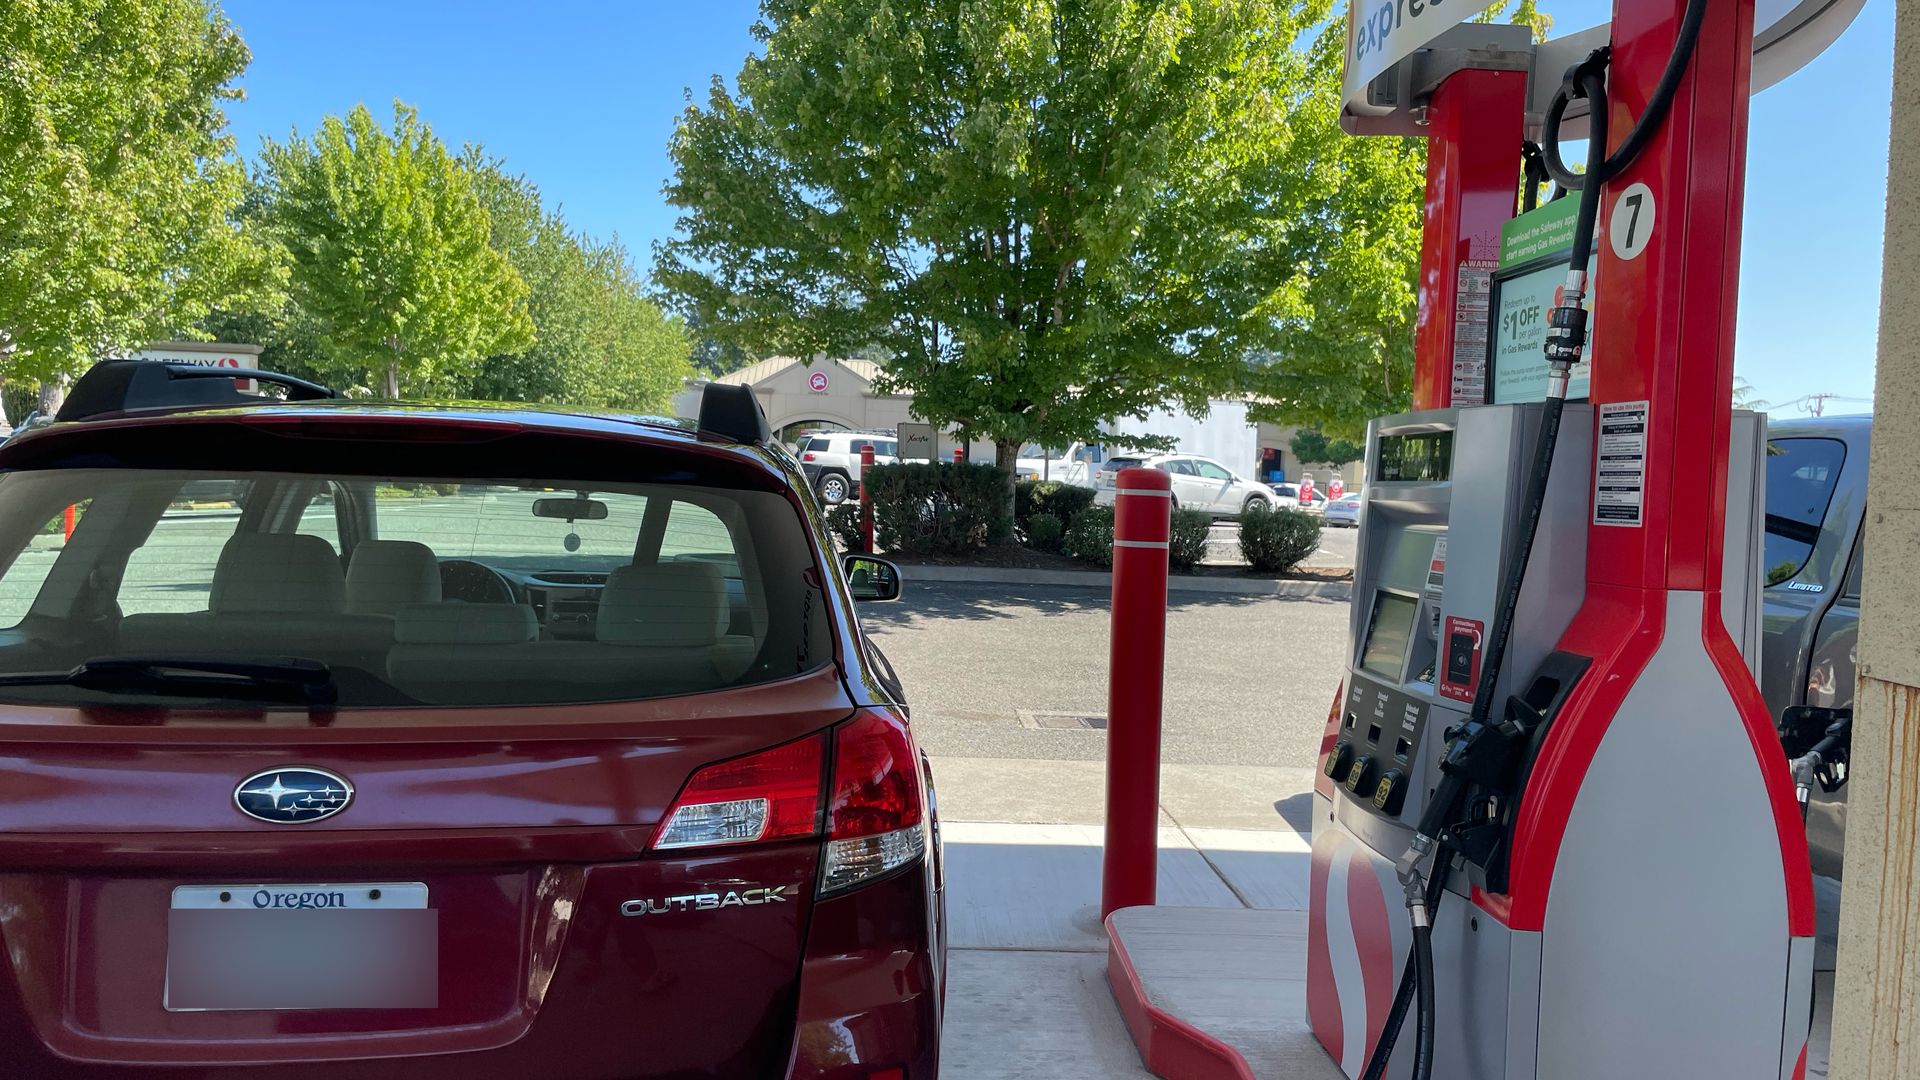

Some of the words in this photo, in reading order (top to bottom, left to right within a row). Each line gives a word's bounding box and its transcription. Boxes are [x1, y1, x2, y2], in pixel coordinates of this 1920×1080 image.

[1506, 229, 1531, 247] Download
[1531, 227, 1540, 237] the
[1540, 219, 1563, 234] Safeway
[1564, 214, 1576, 228] app
[1625, 193, 1643, 249] 7
[1506, 250, 1517, 261] start
[1518, 243, 1537, 257] earning
[1537, 239, 1548, 250] Gas
[1548, 230, 1573, 247] Rewards
[1504, 298, 1523, 308] Redeem
[1523, 297, 1530, 305] up
[1530, 295, 1536, 303] to
[1503, 310, 1518, 340] $1
[1519, 305, 1540, 326] OFF
[1518, 331, 1528, 341] per
[1527, 327, 1542, 339] gallon
[1502, 346, 1507, 355] in
[1508, 344, 1518, 354] Gas
[1788, 581, 1823, 592] LIMITED
[1377, 786, 1388, 801] 92
[252, 889, 348, 909] Oregon
[620, 885, 787, 917] OUTBACK
